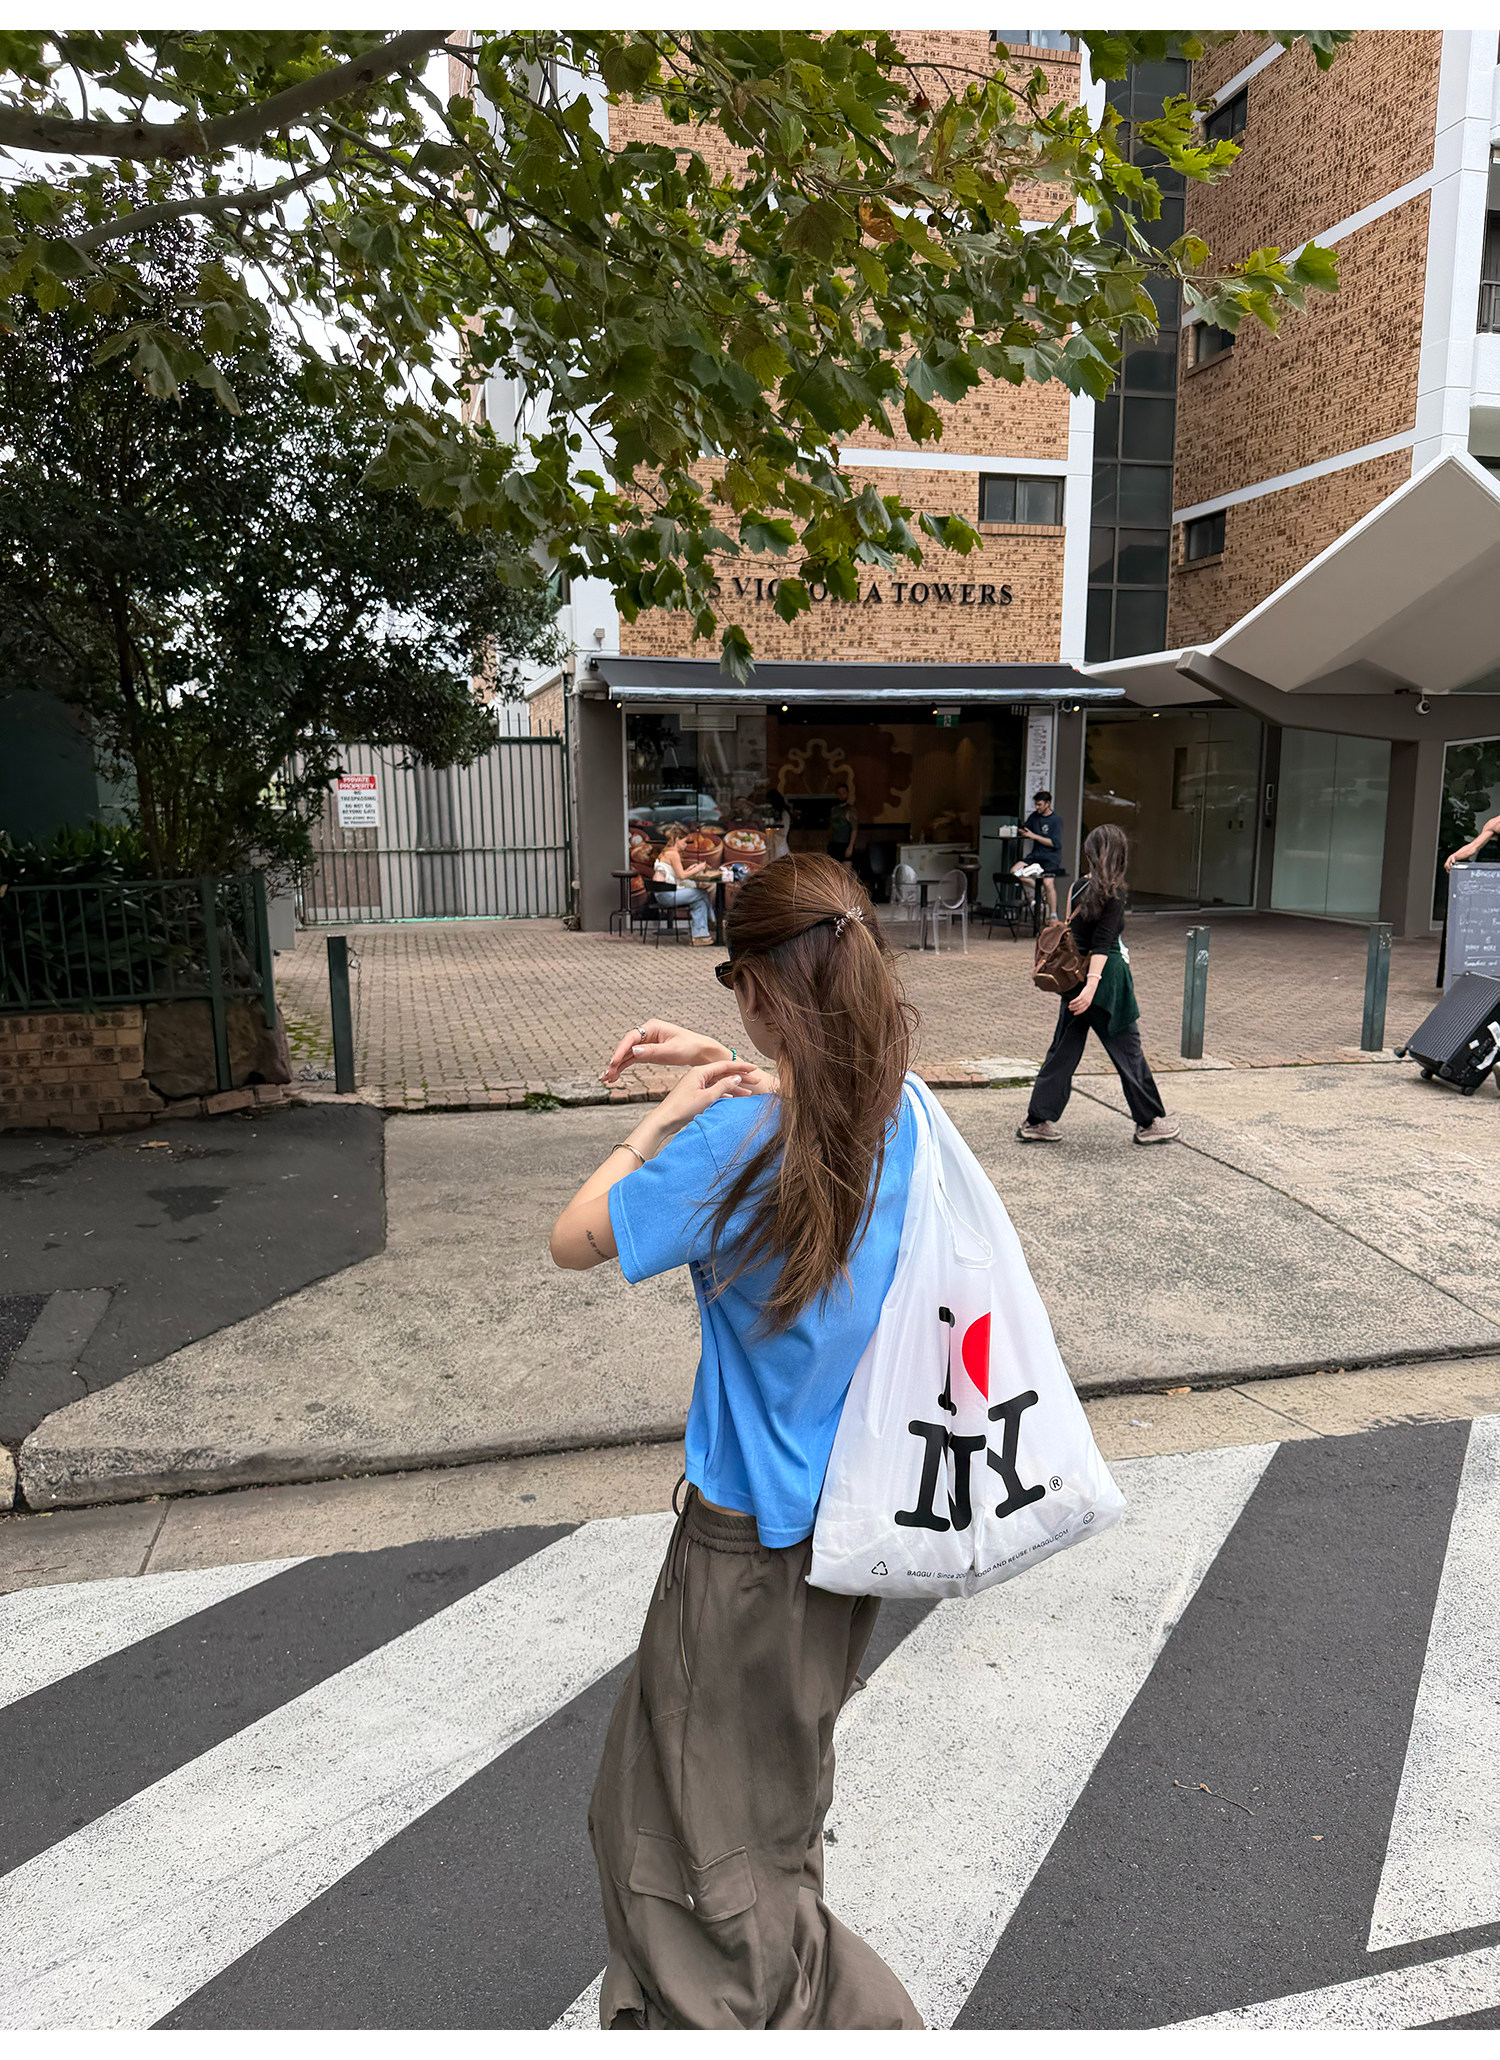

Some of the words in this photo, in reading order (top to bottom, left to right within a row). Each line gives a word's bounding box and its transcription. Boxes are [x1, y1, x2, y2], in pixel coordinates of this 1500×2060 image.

[891, 582, 1013, 606] TOWERS
[938, 1306, 957, 1417] I
[894, 1390, 1046, 1532] NY
[992, 1560, 1007, 1570] AND
[1007, 1549, 1028, 1563] REUSE
[1032, 1528, 1069, 1551] BAGGU.COM
[906, 1570, 932, 1578] BAGGU
